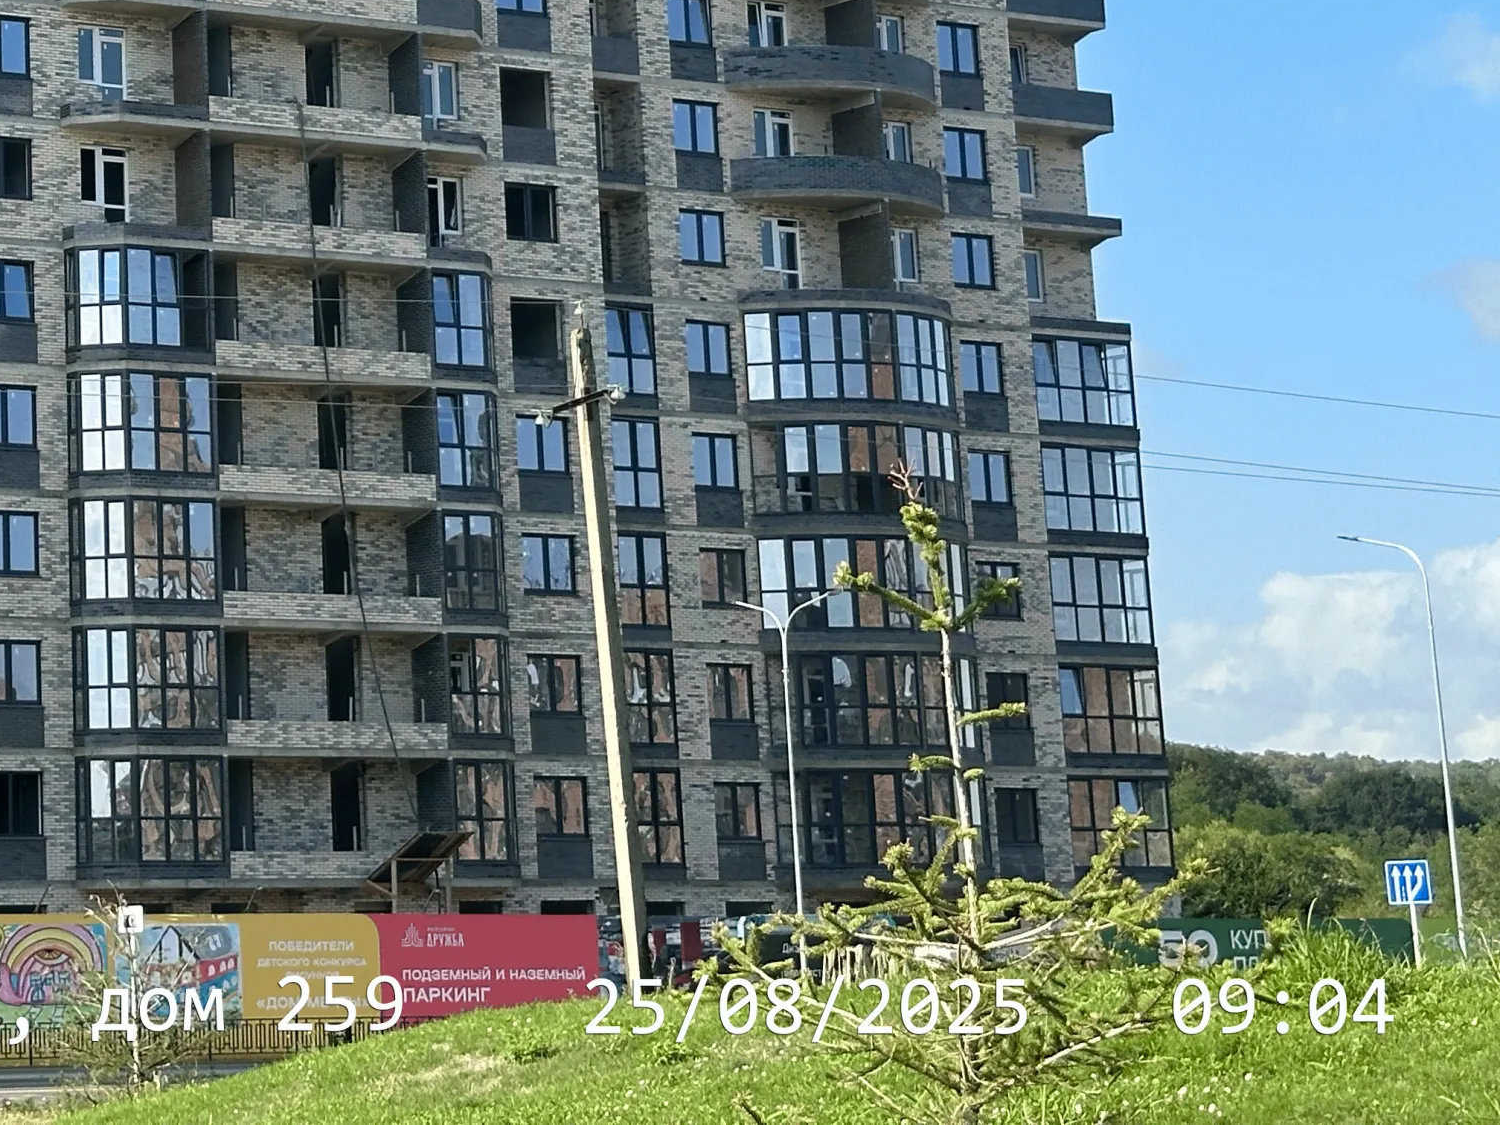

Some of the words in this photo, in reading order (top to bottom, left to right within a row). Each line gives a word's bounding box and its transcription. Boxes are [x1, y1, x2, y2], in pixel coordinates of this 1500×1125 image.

[268, 940, 355, 953] ПОБЕДИТЕЛИ
[426, 932, 465, 947] ДРУЖБА
[257, 957, 310, 968] ДЕТСКОГО
[313, 957, 368, 967] КОНКУРСА
[402, 966, 492, 982] ПОДЗЕМНЫЙ
[496, 969, 505, 980] И
[509, 966, 586, 981] НАЗЕМНЫЙ
[403, 987, 491, 1004] ПАРКИНГ
